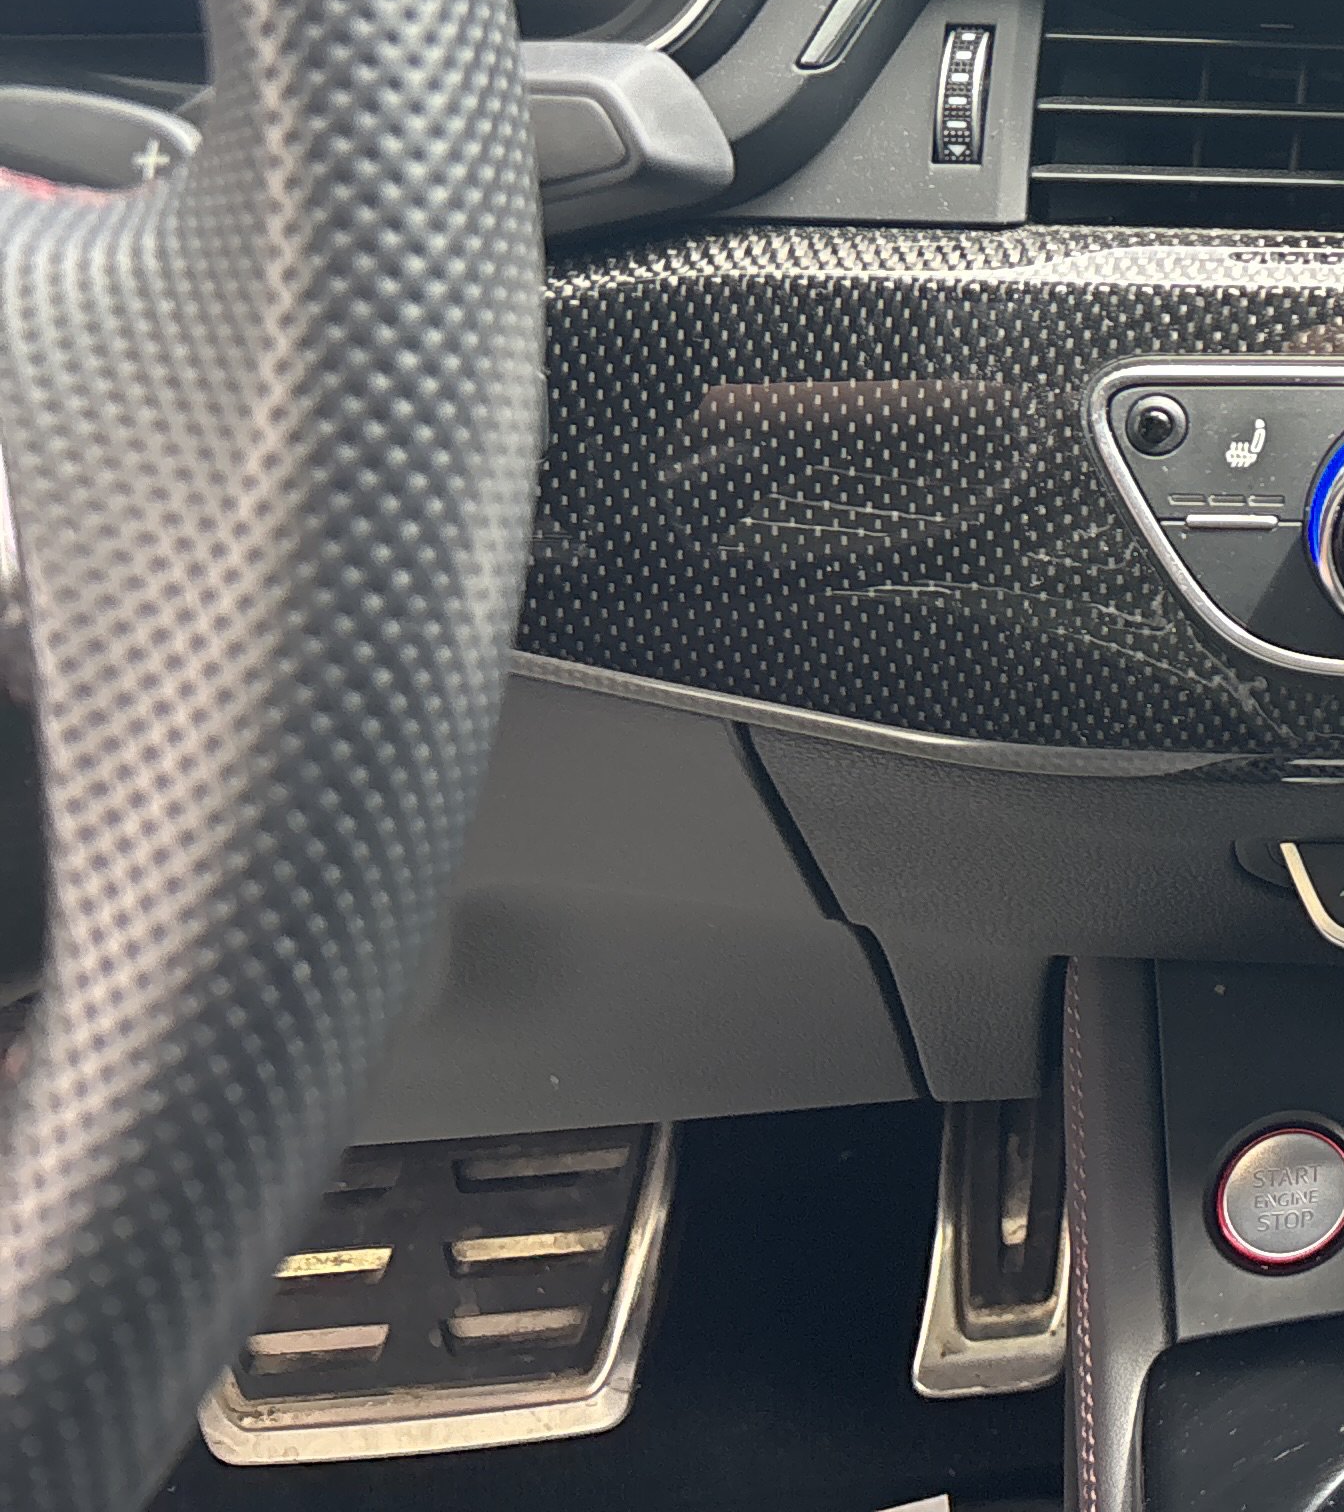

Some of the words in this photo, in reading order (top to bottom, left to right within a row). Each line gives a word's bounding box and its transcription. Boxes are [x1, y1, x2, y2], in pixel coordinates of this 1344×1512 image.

[1253, 1165, 1320, 1188] START
[1254, 1189, 1319, 1209] ENGINE
[1257, 1209, 1314, 1232] STOP
